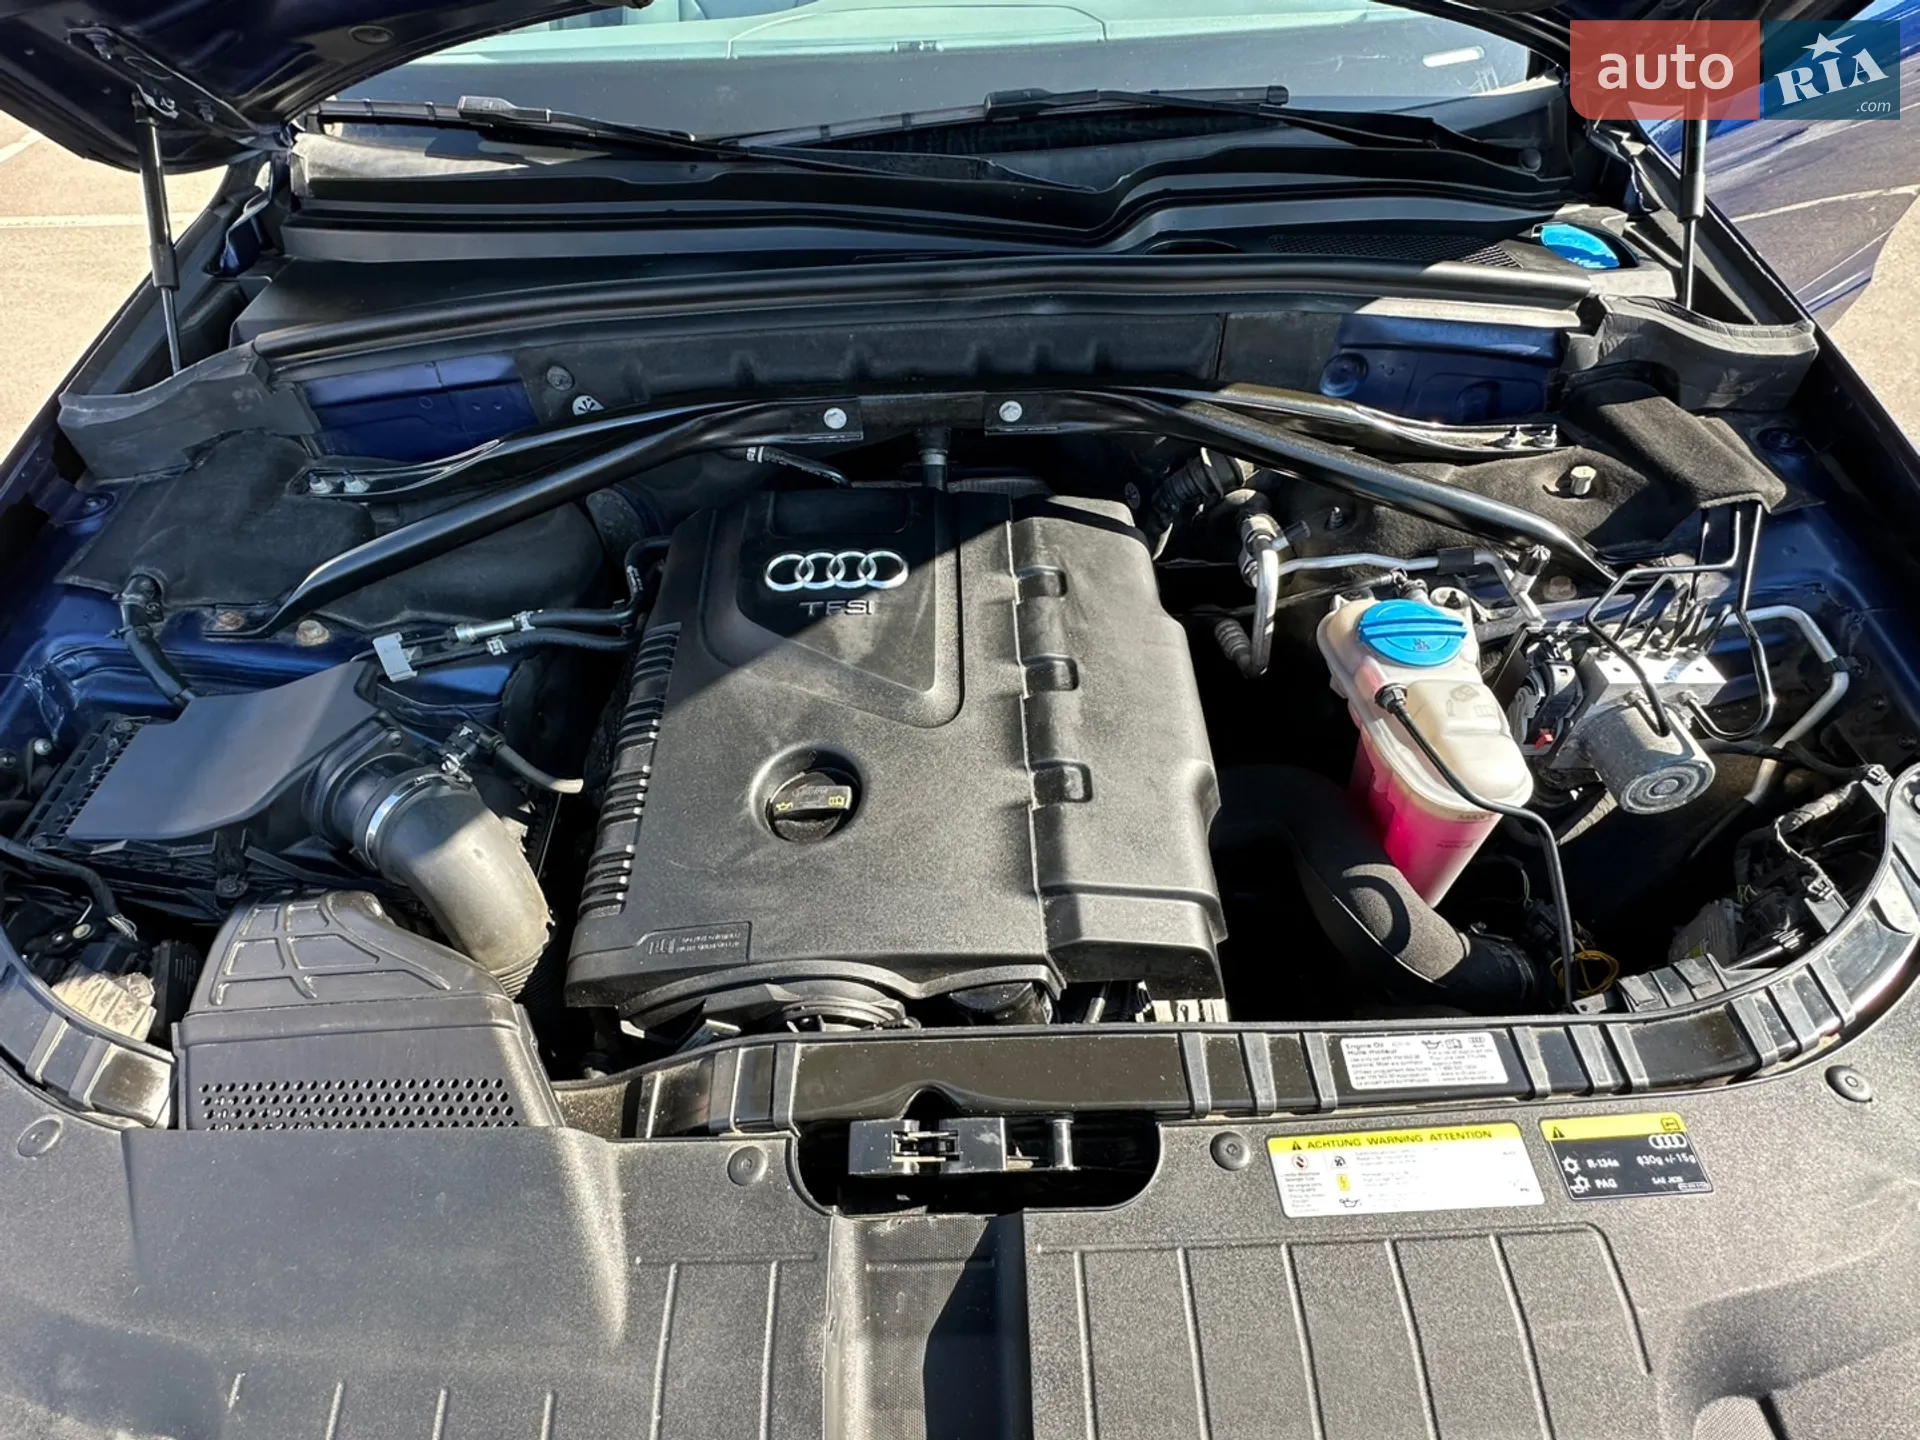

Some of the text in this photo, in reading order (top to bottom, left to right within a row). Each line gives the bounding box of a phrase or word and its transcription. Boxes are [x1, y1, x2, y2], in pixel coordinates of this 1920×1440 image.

[799, 600, 875, 616] TFSI
[1307, 1129, 1493, 1150] ACHTUNG WARNING ATTENTION
[1586, 1156, 1620, 1169] R-134a
[1594, 1177, 1619, 1190] PAG
